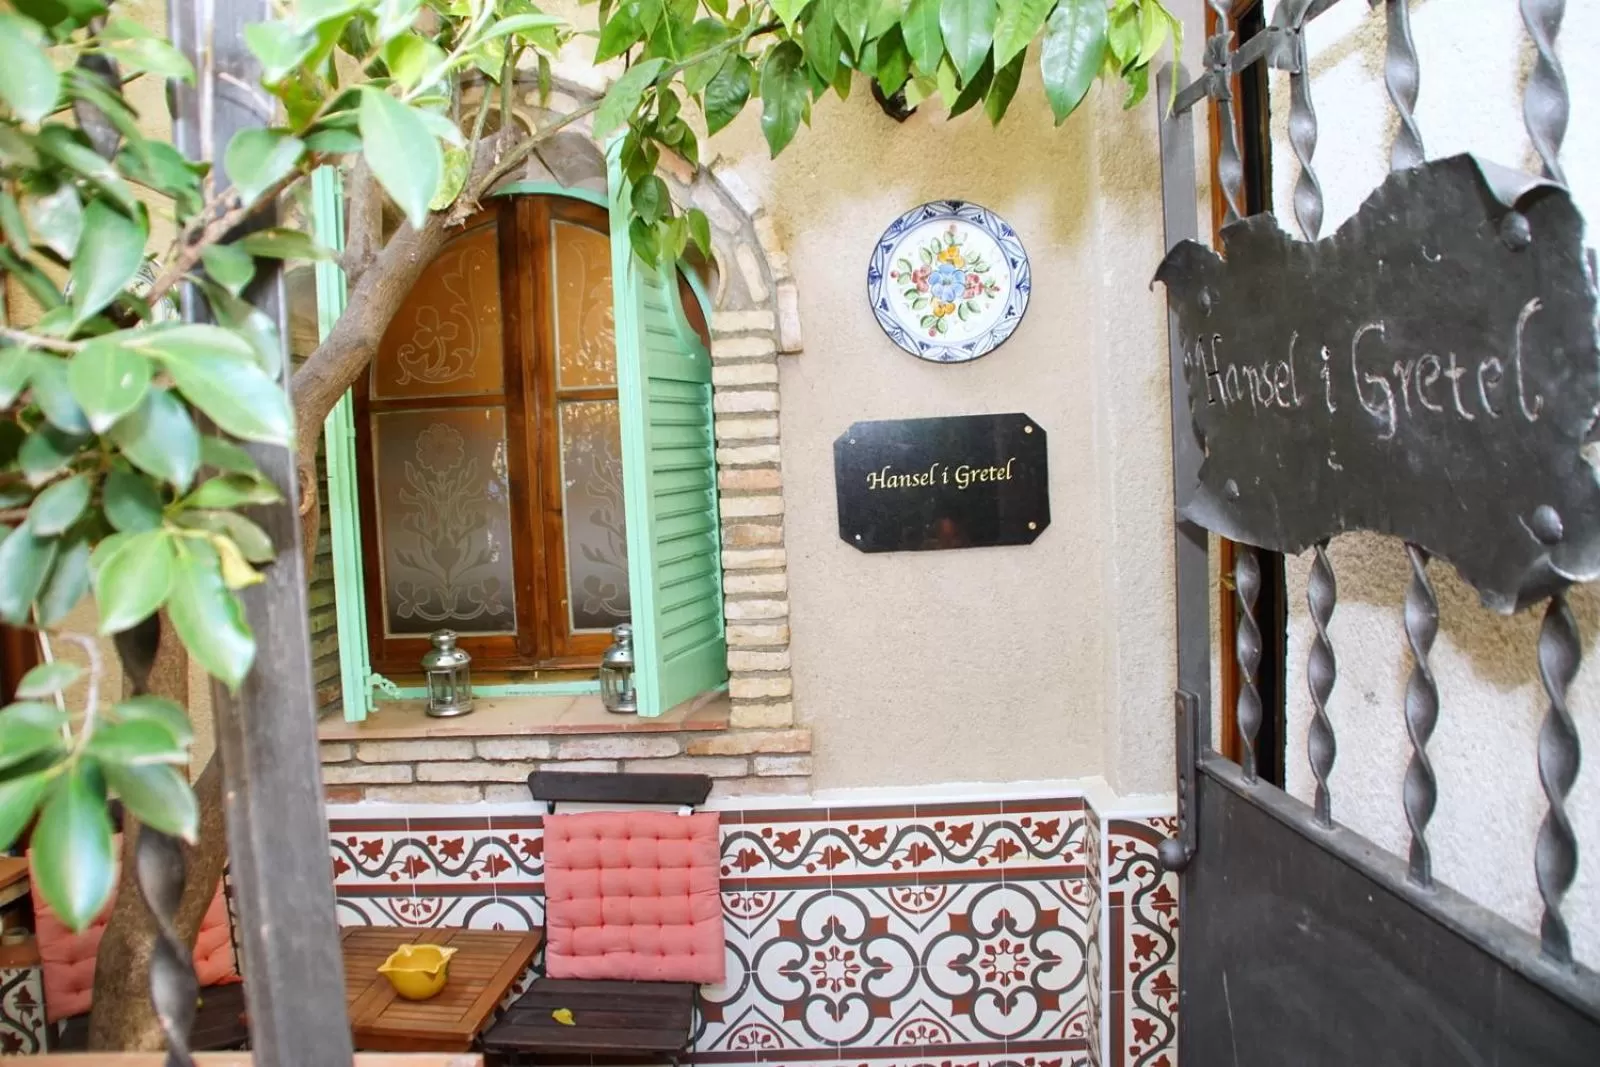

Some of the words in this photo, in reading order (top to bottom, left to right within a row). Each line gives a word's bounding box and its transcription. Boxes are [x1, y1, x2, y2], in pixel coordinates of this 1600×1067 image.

[1186, 330, 1302, 414] Hansel
[1320, 345, 1336, 413] i
[1352, 297, 1543, 440] Gretel
[867, 463, 938, 490] Hansel
[942, 466, 949, 485] i
[955, 457, 1016, 490] Gretel
